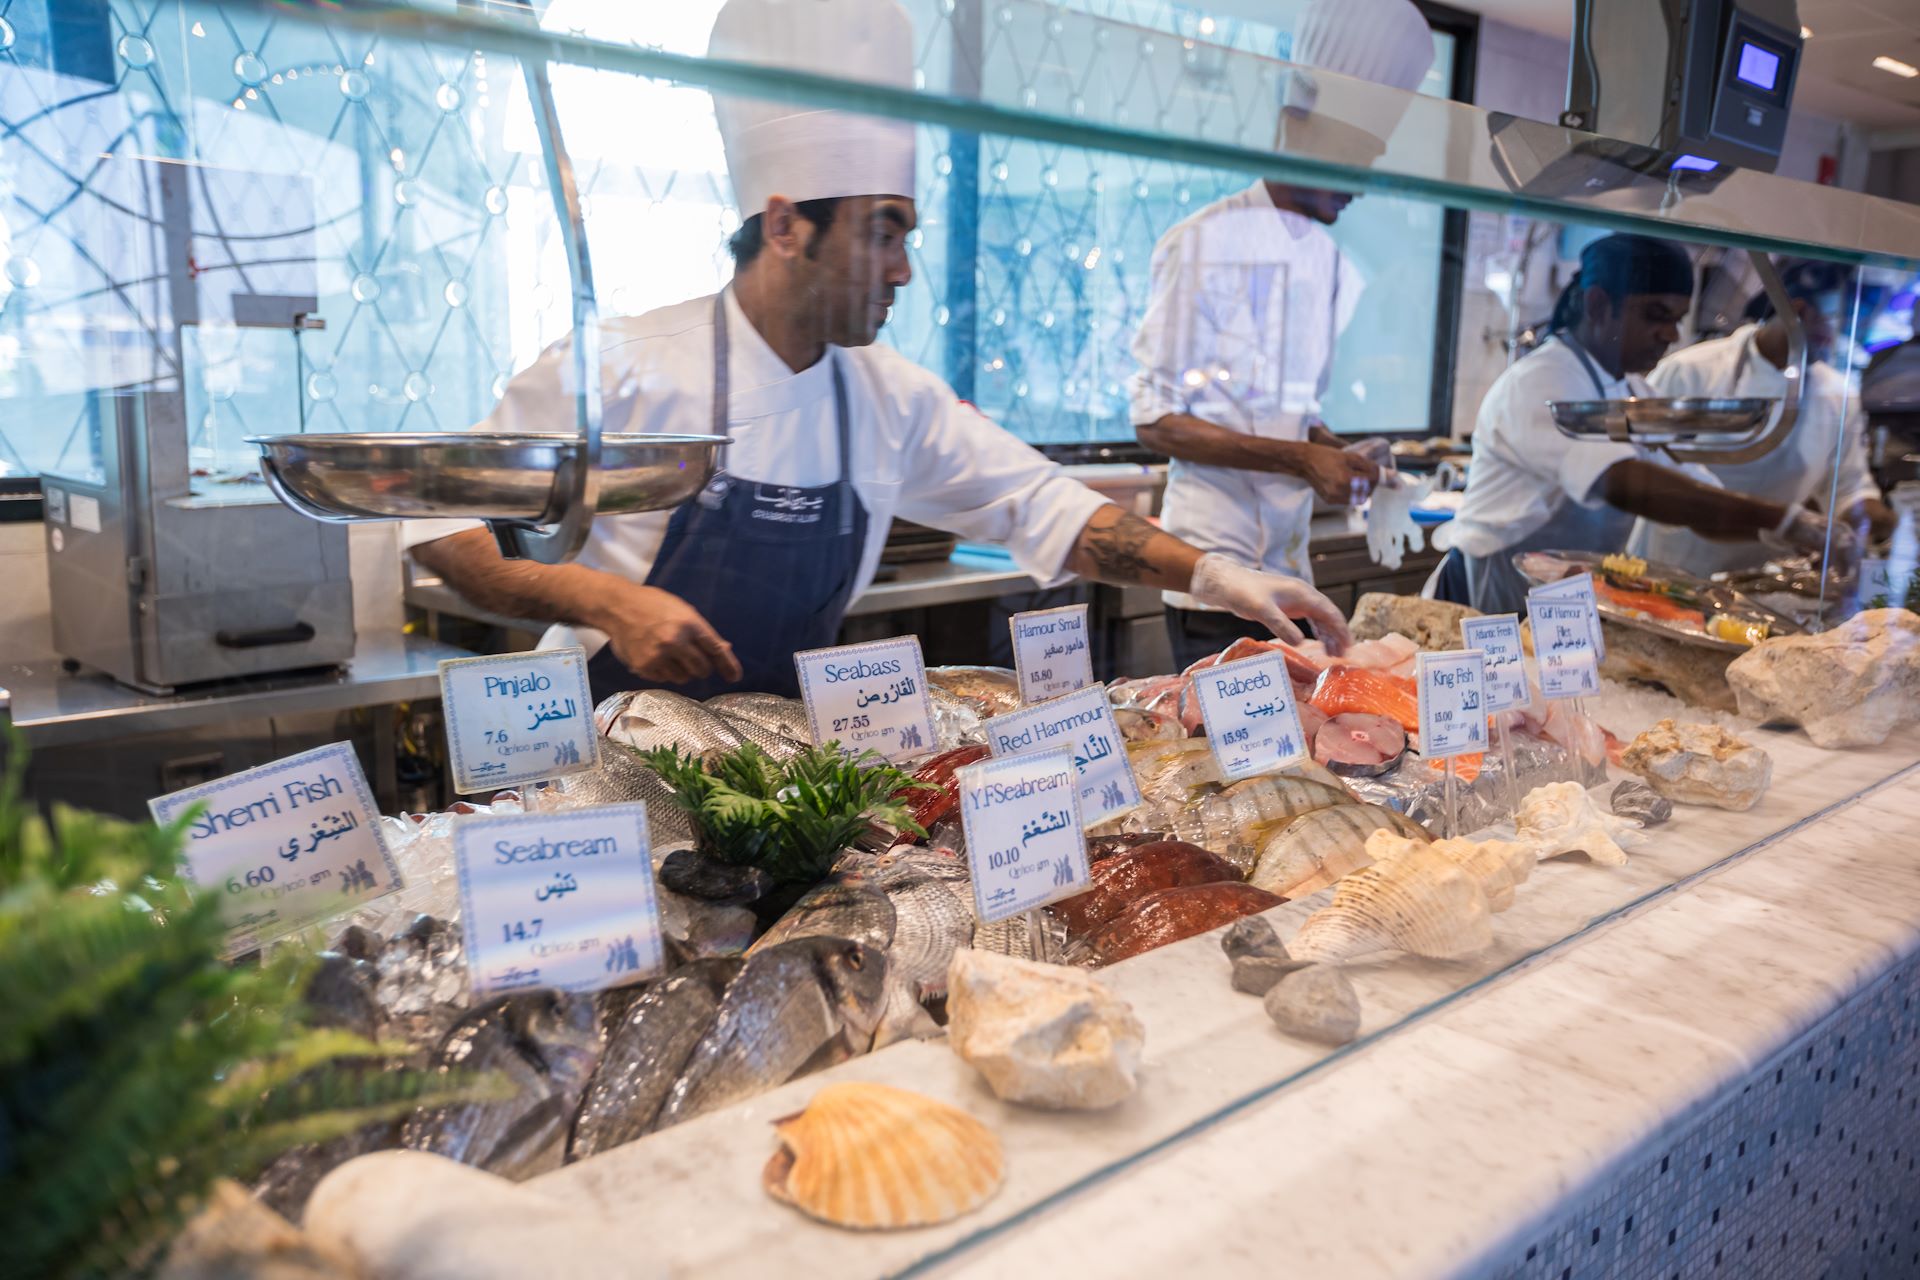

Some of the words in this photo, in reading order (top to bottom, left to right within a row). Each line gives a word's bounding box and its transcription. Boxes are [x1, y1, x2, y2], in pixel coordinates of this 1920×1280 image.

[1019, 623, 1056, 639] Hamour
[1058, 616, 1080, 632] Small
[825, 660, 901, 683] Seabass
[1031, 669, 1052, 683] 15.80
[1433, 670, 1454, 688] King
[1456, 667, 1474, 684] Fish
[485, 672, 550, 698] Pinjalo
[1216, 670, 1271, 699] Rabeeb
[833, 715, 870, 732] 27.55
[881, 726, 895, 736] gm
[998, 728, 1032, 753] Red
[1034, 706, 1104, 740] Hammour
[485, 730, 508, 744] 7.6
[534, 741, 549, 751] gm
[1222, 728, 1249, 745] 15.95
[284, 774, 343, 809] Fish
[495, 837, 617, 865] Seabream
[989, 847, 1020, 870] 10.10
[226, 865, 275, 894] 6.60
[503, 919, 543, 943] 14.7
